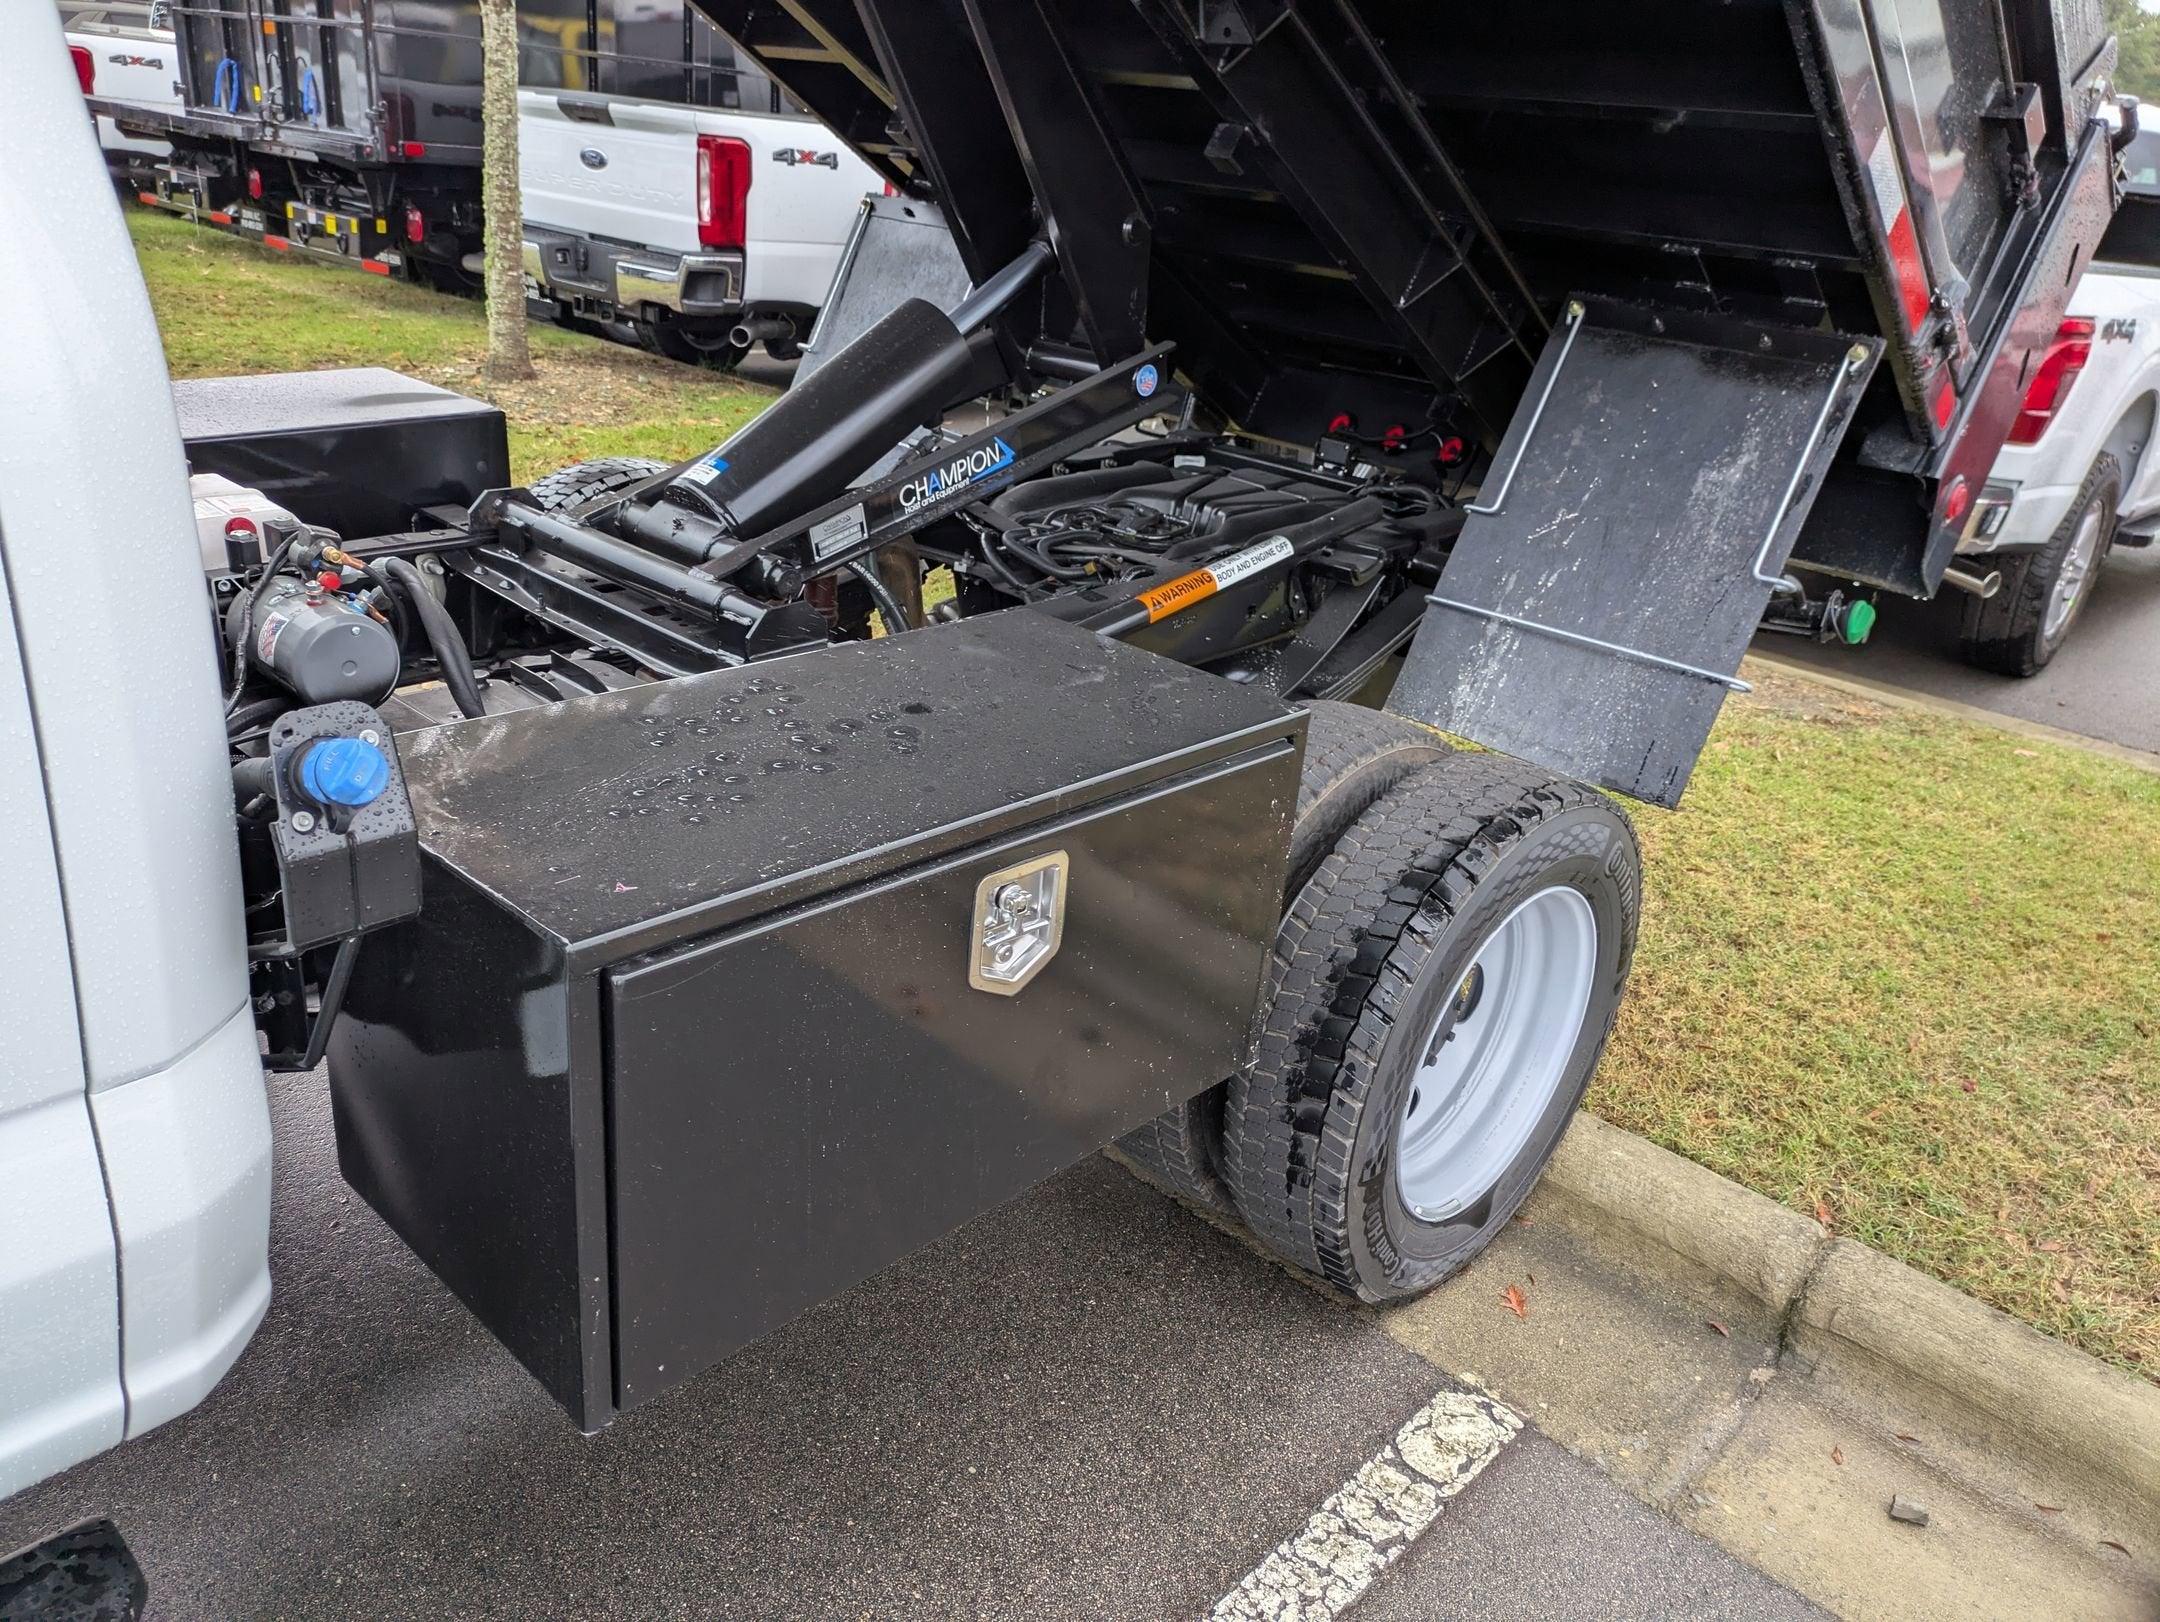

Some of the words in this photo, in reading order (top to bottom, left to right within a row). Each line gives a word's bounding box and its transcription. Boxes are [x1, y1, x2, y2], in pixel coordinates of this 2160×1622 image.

[607, 182, 684, 206] DUTY
[900, 443, 1000, 507] CHAMPION
[905, 500, 921, 514] Hoist
[921, 494, 936, 508] and
[936, 477, 970, 500] Equipment
[1217, 568, 1236, 583] BODY
[1237, 558, 1252, 572] AND
[1252, 548, 1276, 569] ENGINE
[1276, 540, 1289, 553] OFF
[1158, 572, 1213, 603] WARNING
